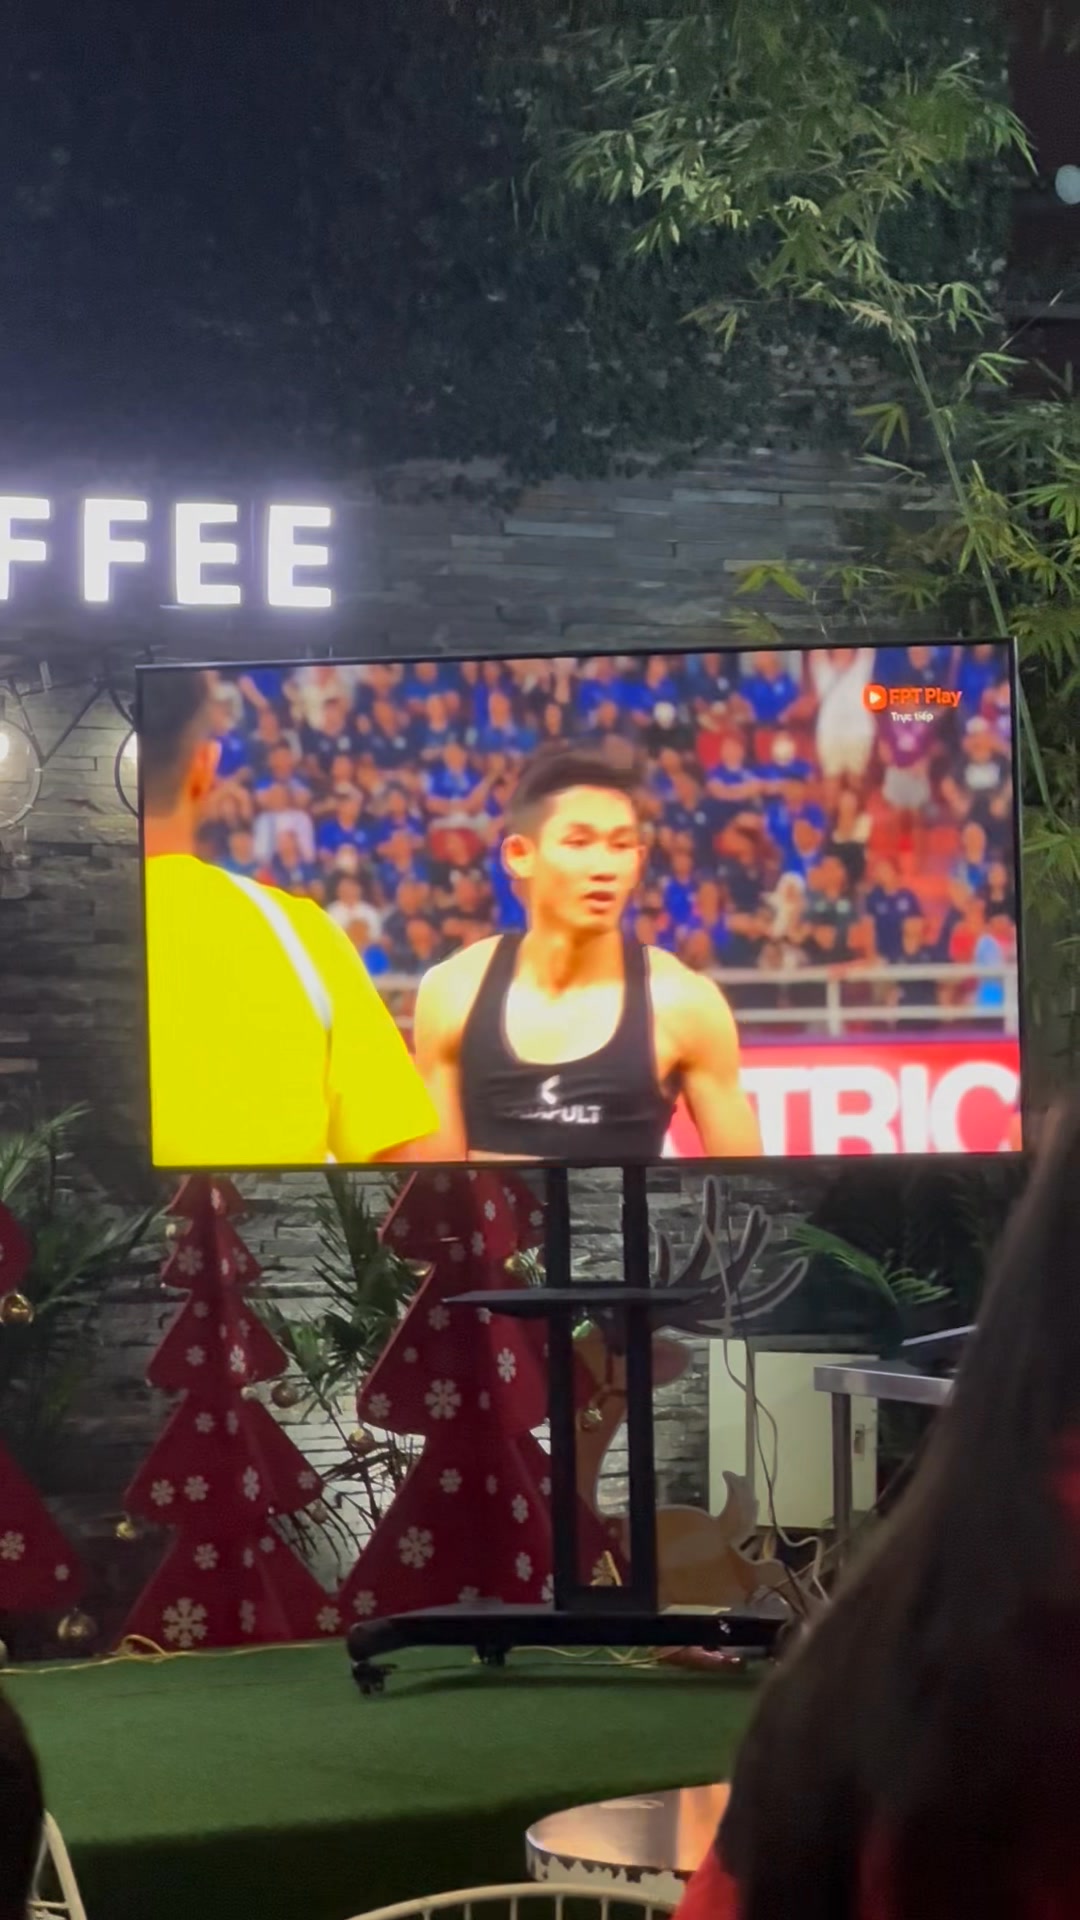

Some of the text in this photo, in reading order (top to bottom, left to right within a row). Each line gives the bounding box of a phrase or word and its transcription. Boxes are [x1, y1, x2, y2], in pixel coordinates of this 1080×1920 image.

[0, 496, 332, 608] FFEE
[889, 687, 962, 707] FPT Play
[738, 1060, 1019, 1155] TRIC
